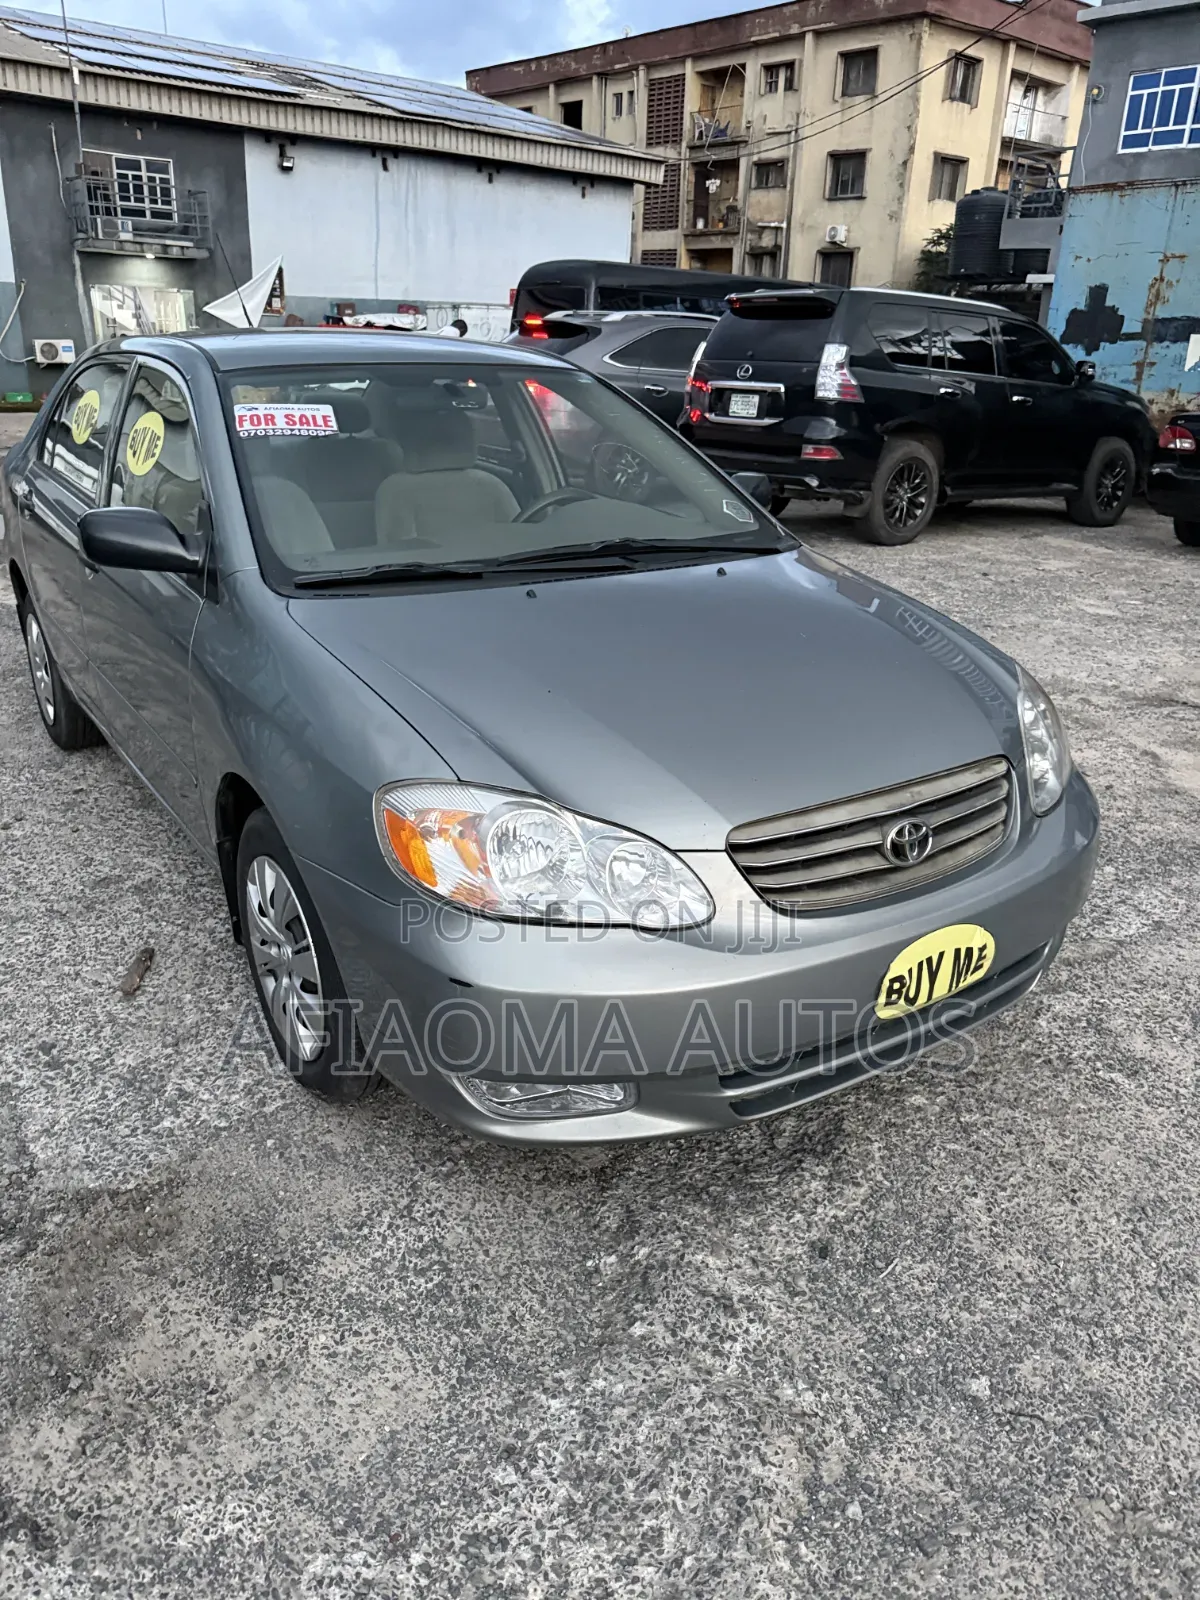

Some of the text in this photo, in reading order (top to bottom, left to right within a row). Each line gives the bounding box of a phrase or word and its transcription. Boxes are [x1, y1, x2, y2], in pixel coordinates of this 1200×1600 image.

[237, 413, 334, 429] FOR SALE
[129, 426, 162, 466] BUY ME
[883, 943, 988, 1007] BUY ME
